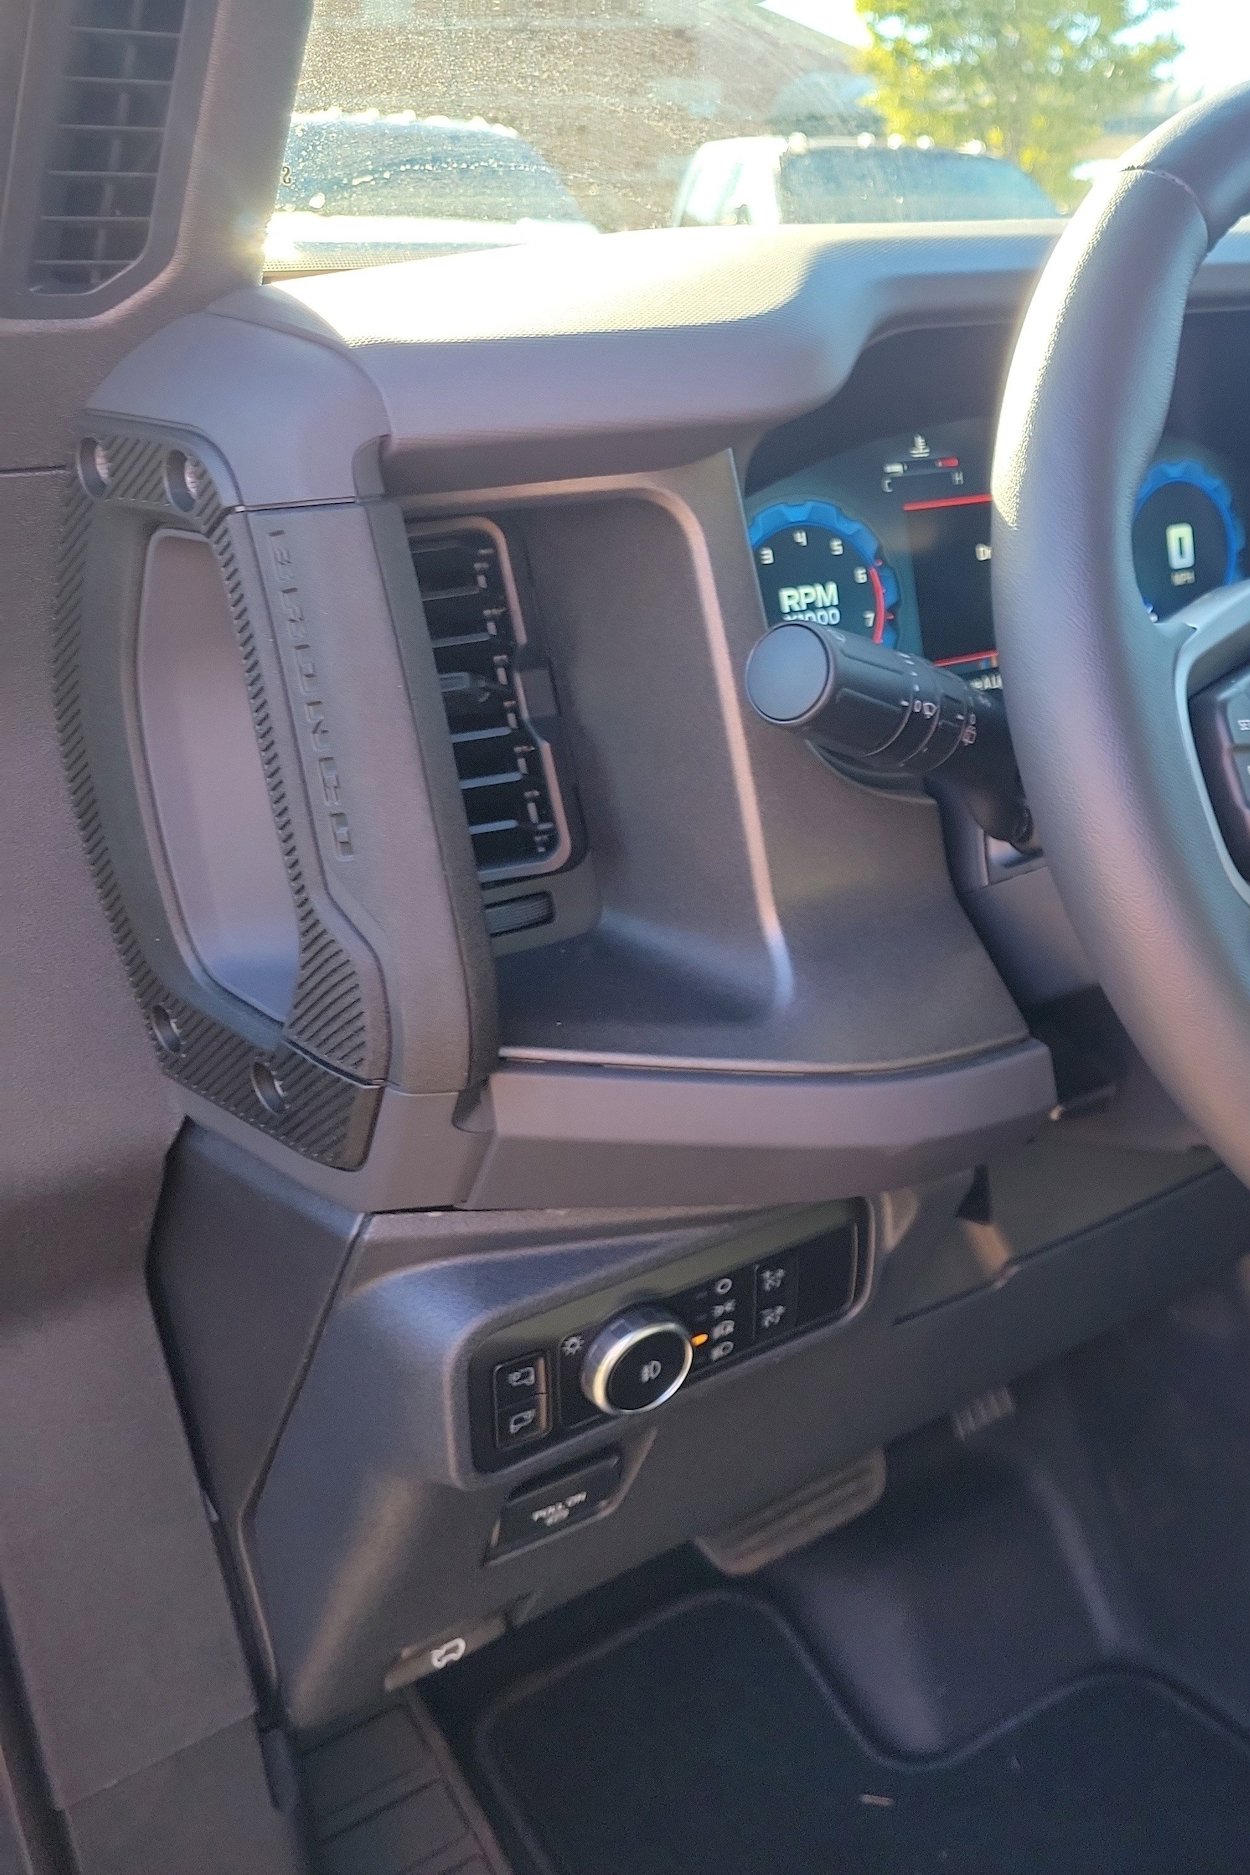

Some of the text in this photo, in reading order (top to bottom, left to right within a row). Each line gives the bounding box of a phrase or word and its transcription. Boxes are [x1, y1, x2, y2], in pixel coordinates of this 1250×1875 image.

[882, 477, 893, 493] C
[951, 470, 964, 485] H
[792, 529, 808, 547] 4
[830, 537, 844, 556] 5
[1165, 522, 1196, 570] 0
[759, 546, 774, 565] 3
[854, 566, 868, 584] 6
[779, 580, 840, 613] RPM
[864, 610, 877, 628] 7
[269, 529, 354, 862] BRONCO
